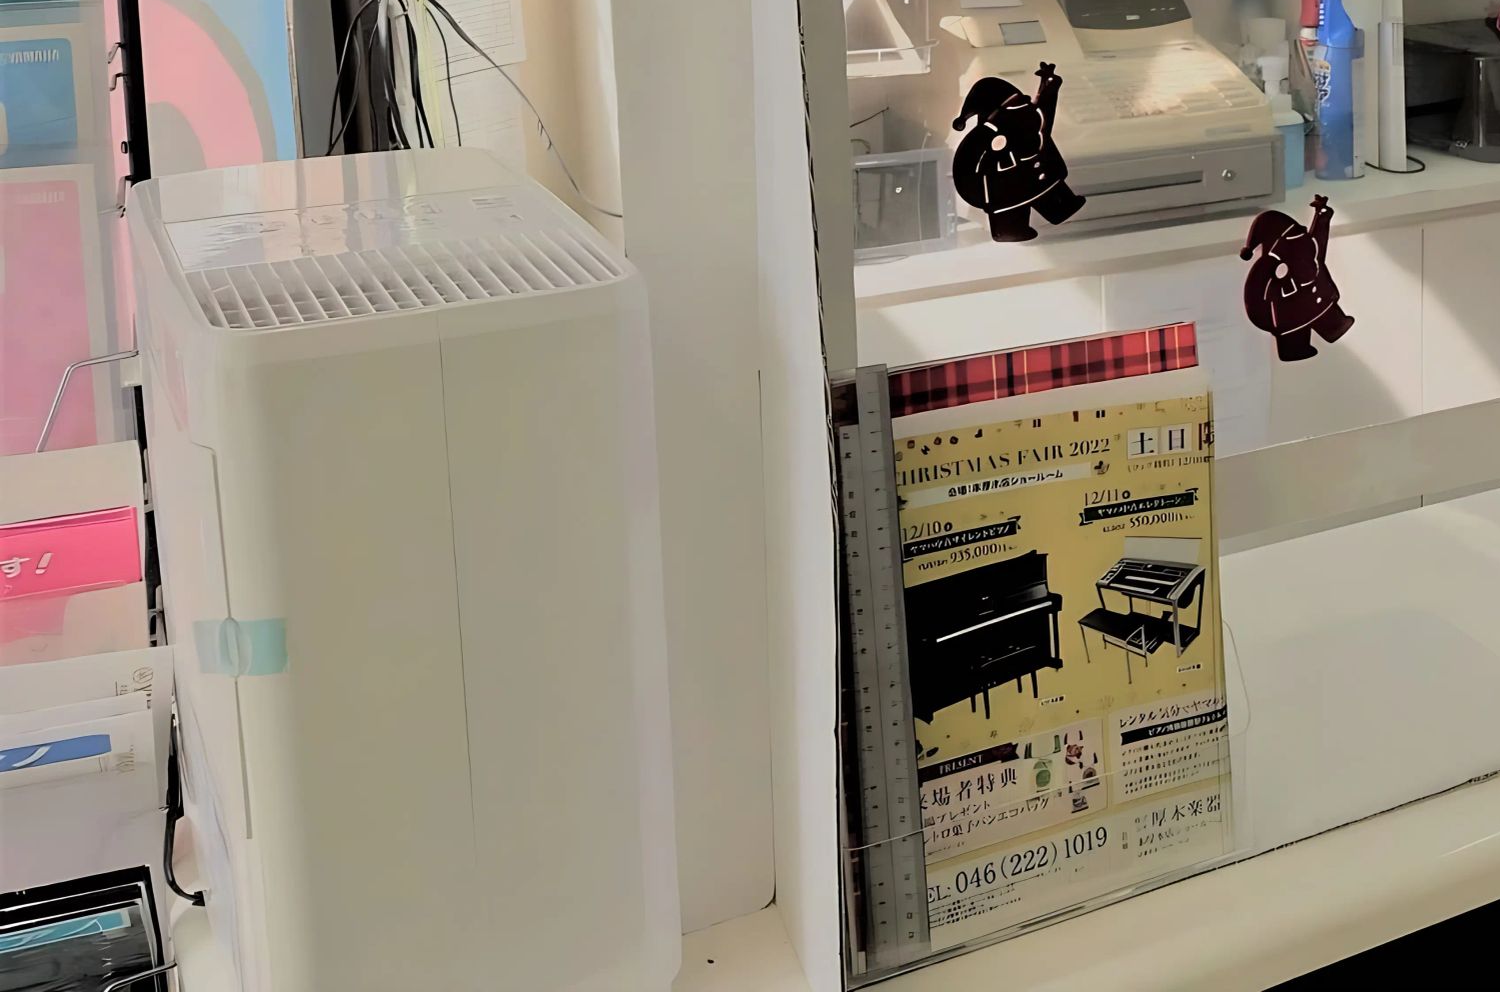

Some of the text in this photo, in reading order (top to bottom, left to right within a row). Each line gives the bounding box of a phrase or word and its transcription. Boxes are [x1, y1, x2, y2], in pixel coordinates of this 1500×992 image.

[1017, 444, 1064, 465] FAIR
[1069, 438, 1111, 457] 2022
[955, 826, 1108, 895] 046(222)1019
